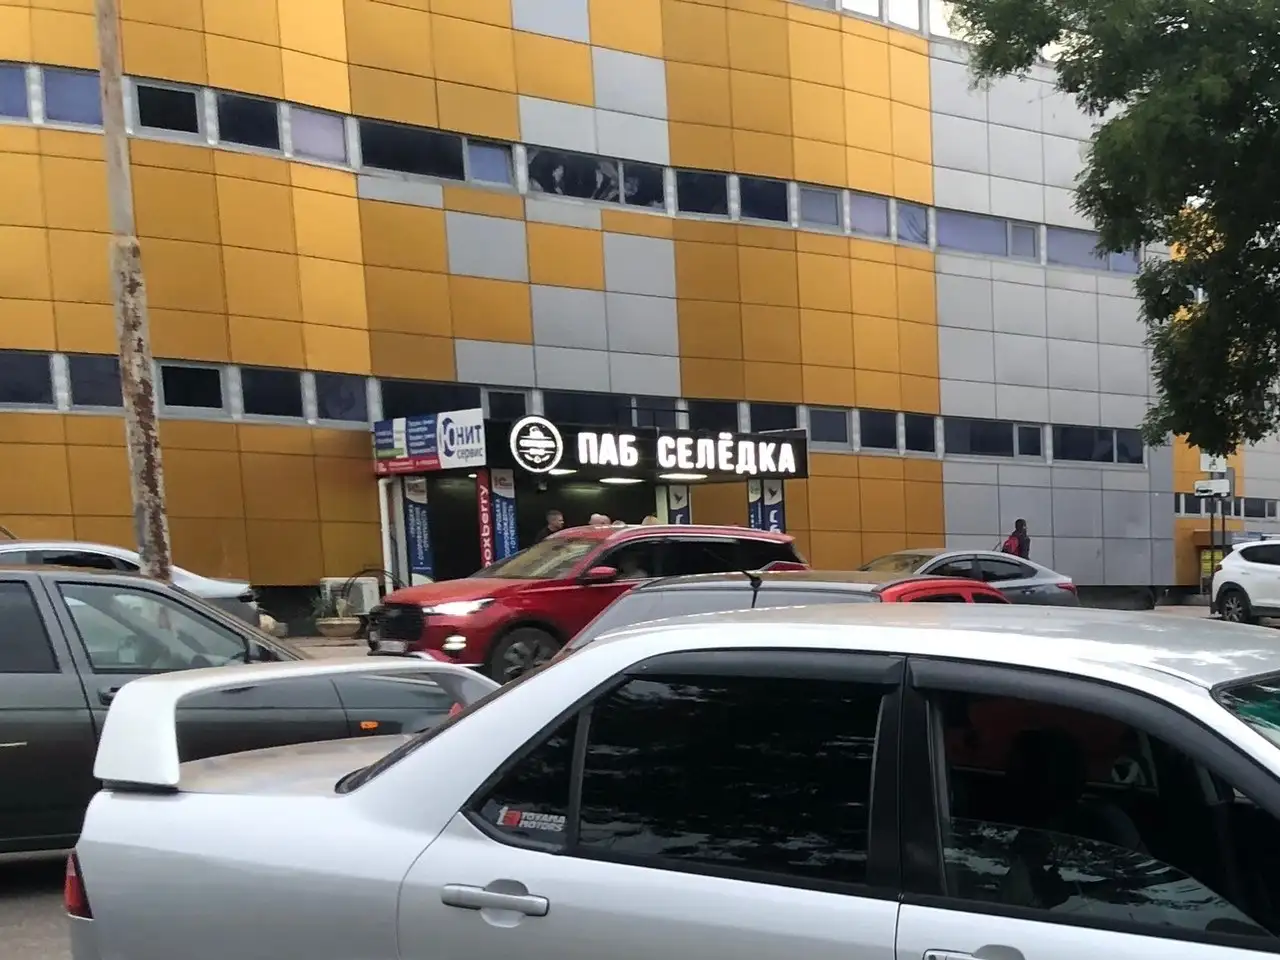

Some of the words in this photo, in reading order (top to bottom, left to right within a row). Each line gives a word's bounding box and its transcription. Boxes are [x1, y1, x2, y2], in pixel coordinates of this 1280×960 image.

[442, 417, 482, 457] ЮНИТ
[577, 431, 638, 466] ПАБ
[656, 432, 796, 475] СЕЛЁДКА
[518, 820, 565, 832] MOTORS
[520, 811, 567, 823] TOYAMA
